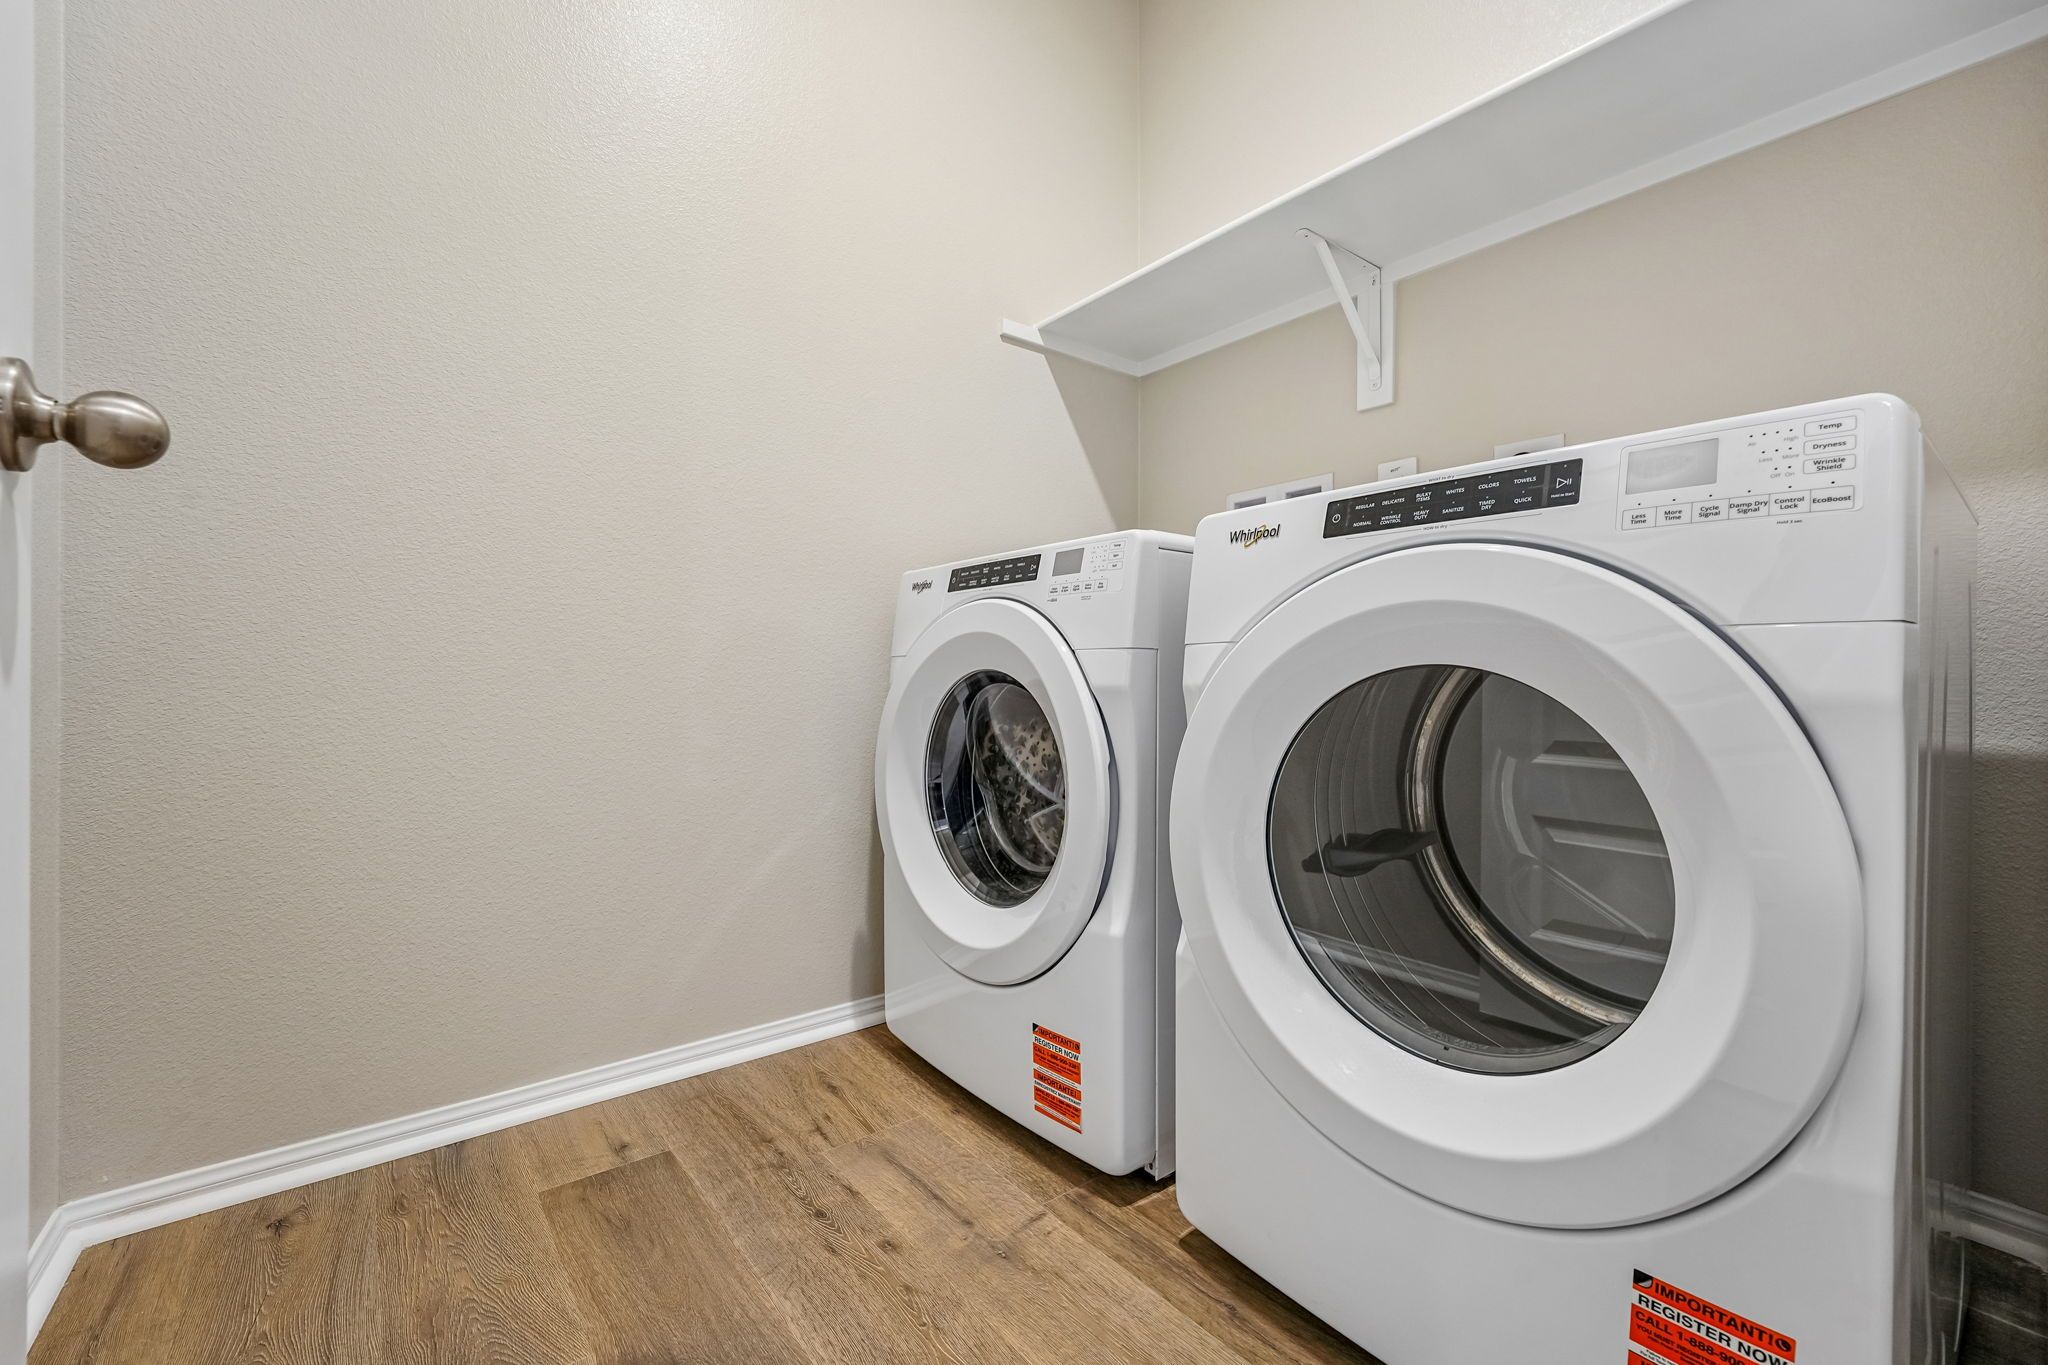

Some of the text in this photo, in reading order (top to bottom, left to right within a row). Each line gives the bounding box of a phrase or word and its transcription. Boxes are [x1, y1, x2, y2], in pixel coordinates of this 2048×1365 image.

[1818, 421, 1843, 430] Temp
[1812, 440, 1847, 450] Dryness
[1812, 457, 1847, 466] Wrinkle
[1816, 463, 1843, 472] Shield
[1513, 475, 1537, 485] TOWELS
[1478, 481, 1500, 490] COLORS
[1445, 487, 1465, 495] WHITES
[1381, 497, 1405, 506] DELICATES
[1513, 496, 1532, 504] QUICK
[1774, 496, 1805, 504] Control
[1812, 495, 1851, 504] EcoBoost
[1355, 502, 1375, 510] REGULAR
[1442, 505, 1465, 514] SANITIZE
[1700, 504, 1720, 512] Cycle
[1729, 501, 1753, 509] Damp
[1779, 502, 1799, 510] Lock
[1698, 510, 1721, 518] Signal
[1736, 507, 1760, 515] Signal
[1381, 513, 1402, 521] WRINKLE
[1380, 518, 1401, 526] CONTROL
[1229, 523, 1281, 544] Whirlpool
[911, 579, 934, 593] Whirlpool
[1034, 1036, 1063, 1054] REGISTER
[1063, 1049, 1080, 1061] NOW
[1654, 1282, 1774, 1346] IMPORTANT!
[1635, 1310, 1672, 1335] CALL
[1637, 1293, 1731, 1348] REGISTER
[1636, 1323, 1653, 1335] YOU
[1653, 1330, 1674, 1346] MUST
